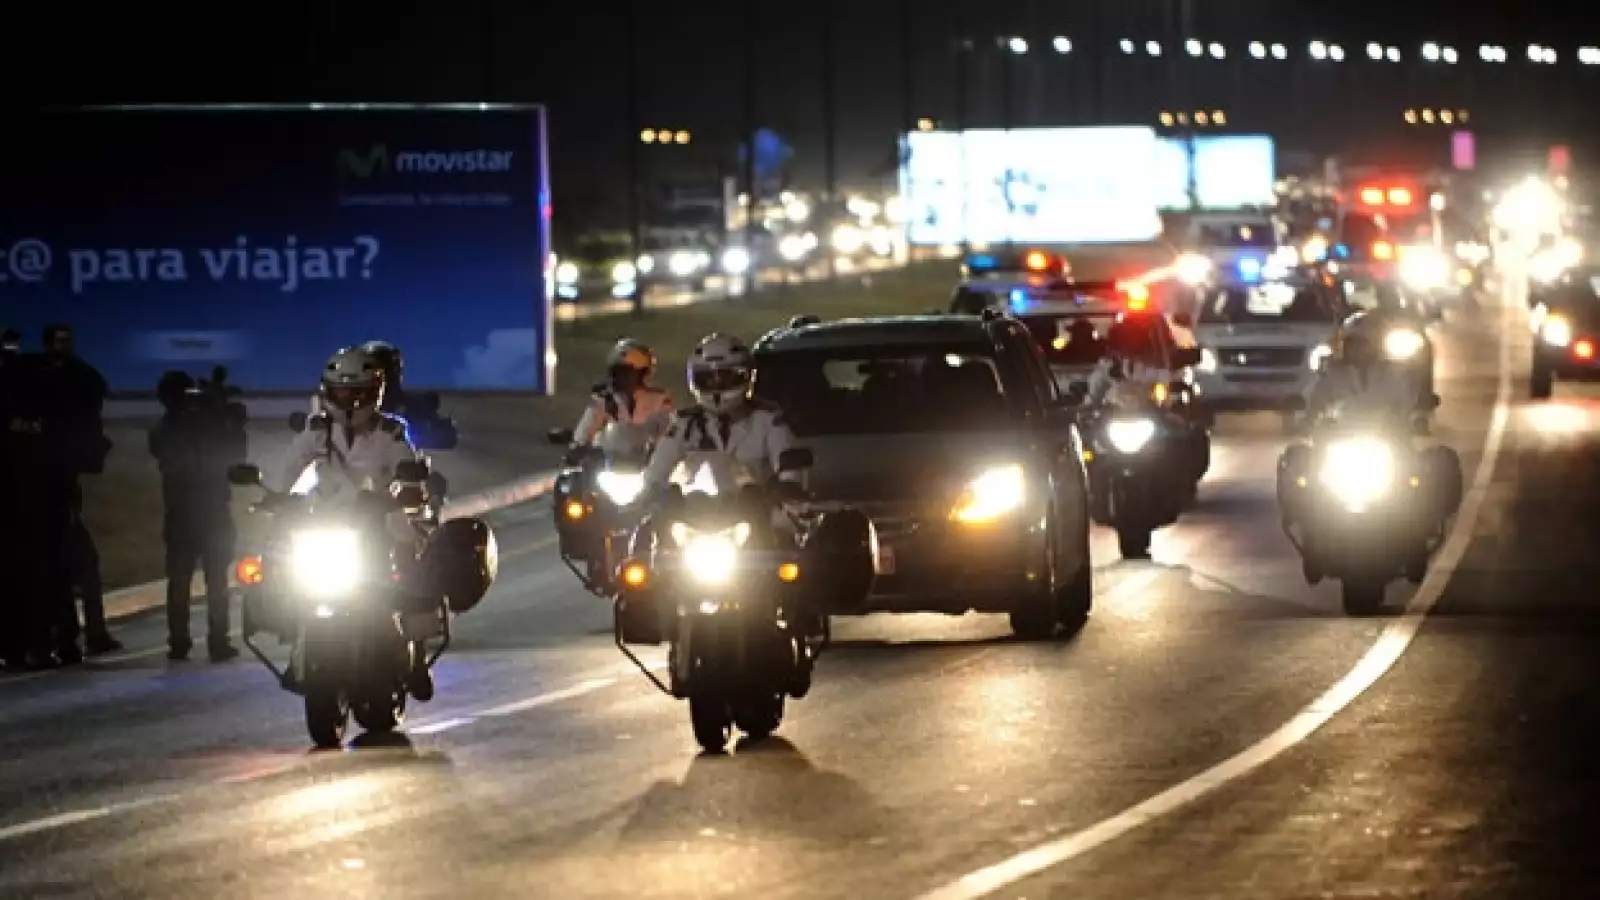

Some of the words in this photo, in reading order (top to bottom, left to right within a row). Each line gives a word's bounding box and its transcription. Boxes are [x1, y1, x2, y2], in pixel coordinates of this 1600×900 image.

[395, 148, 513, 172] movistar
[68, 247, 187, 293] para
[200, 235, 380, 292] viajar?
